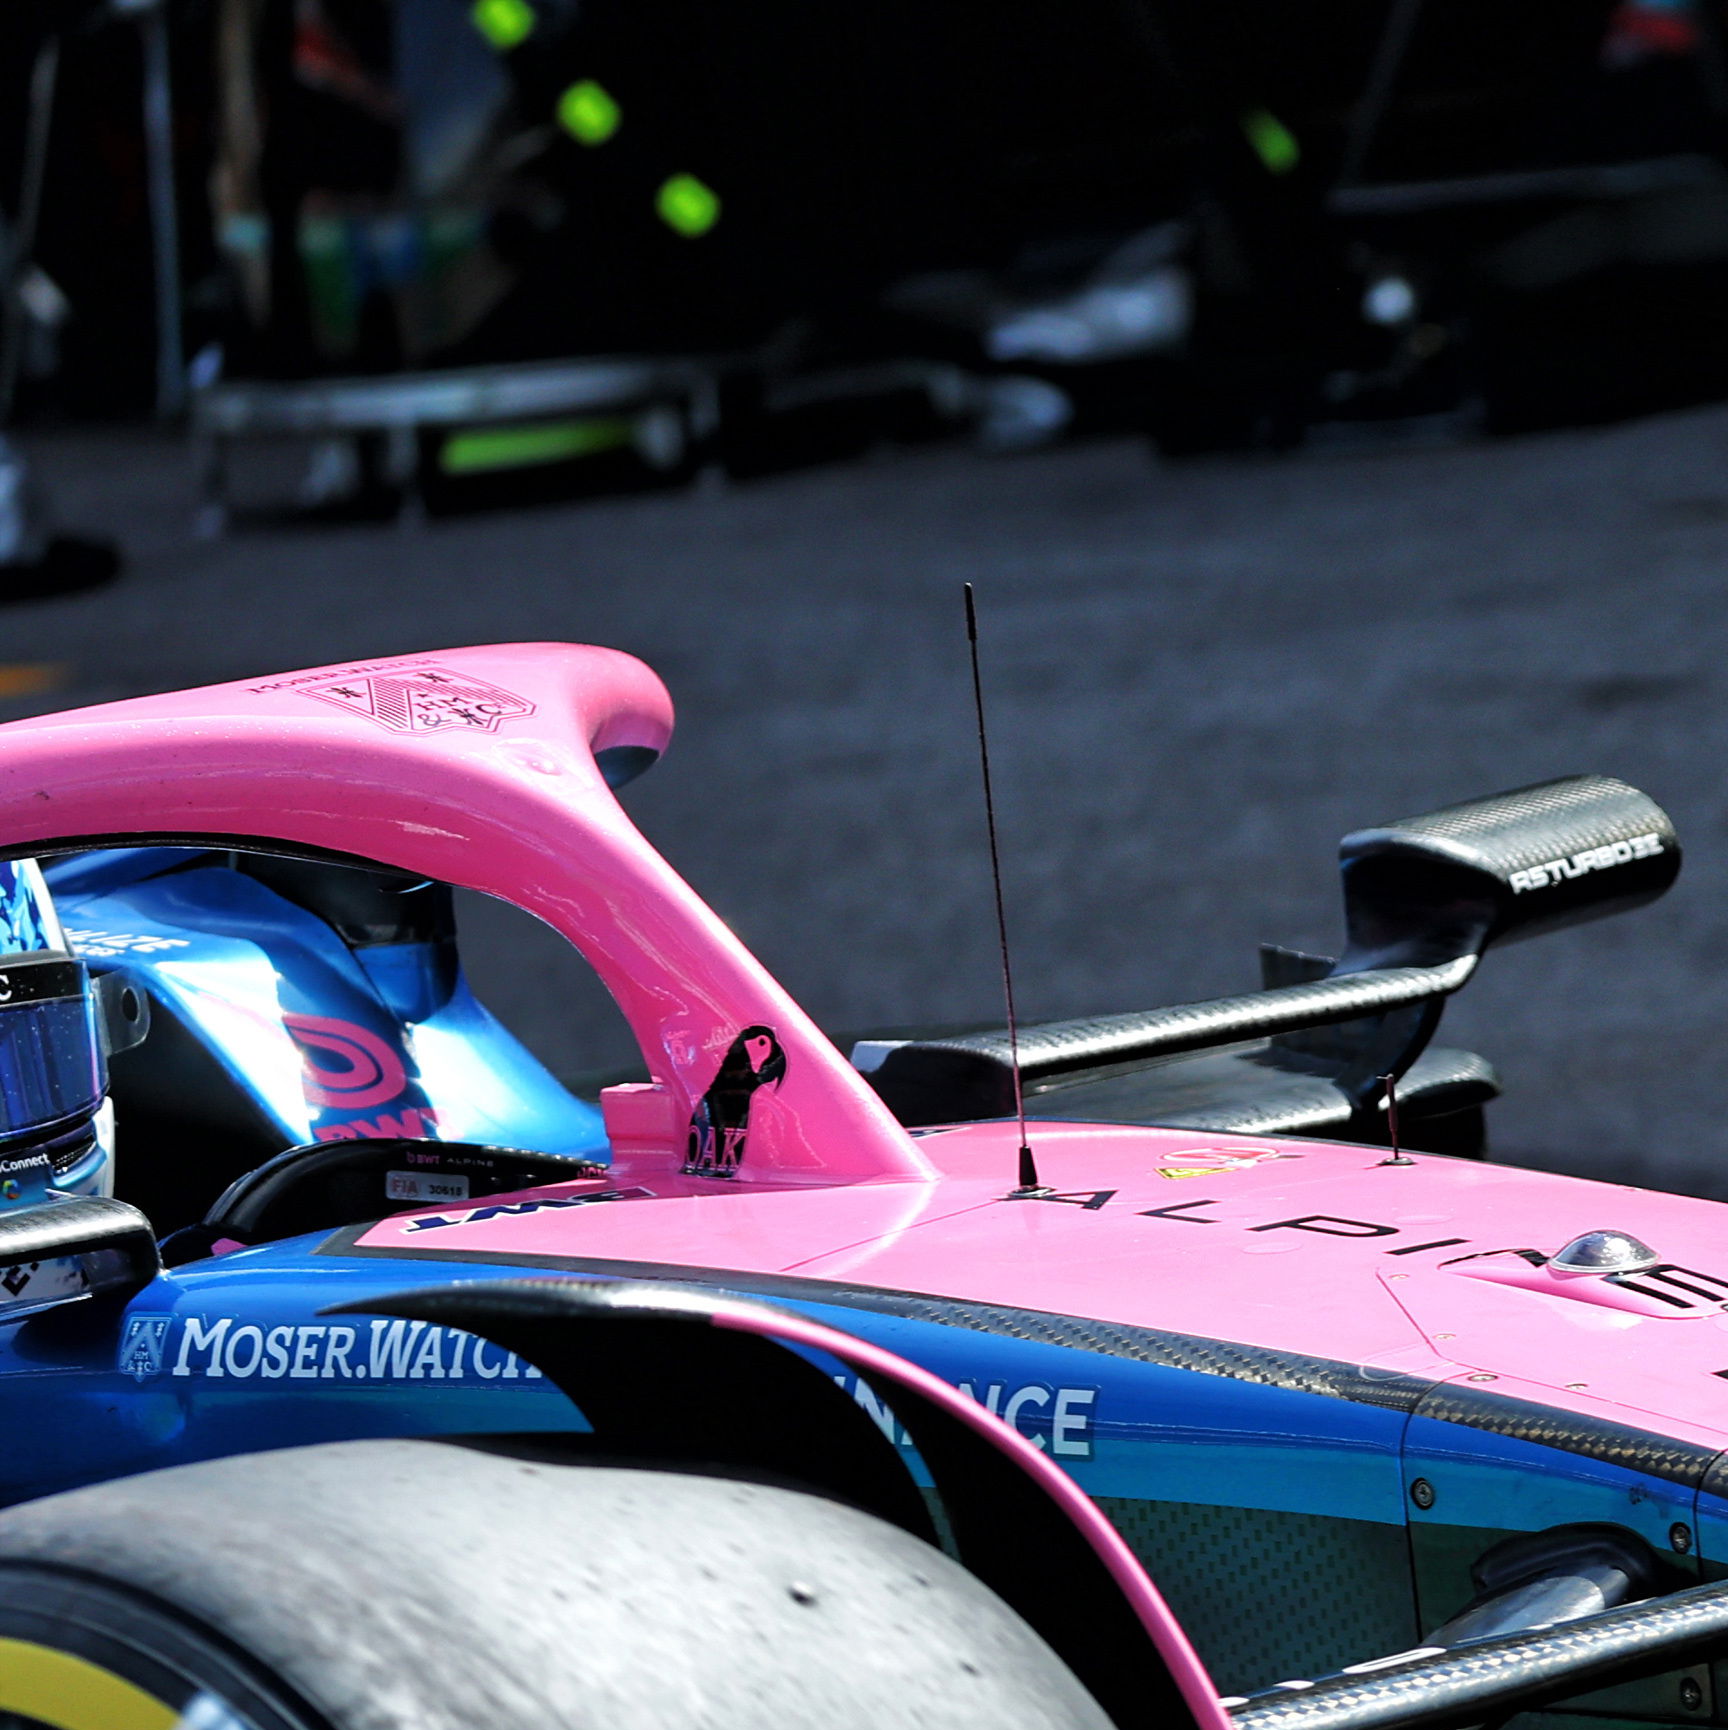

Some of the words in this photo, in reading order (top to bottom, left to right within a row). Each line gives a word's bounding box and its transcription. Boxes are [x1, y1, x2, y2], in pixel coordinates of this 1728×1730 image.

[685, 1125, 748, 1172] OAK
[0, 1153, 50, 1173] Connect
[447, 1157, 494, 1167] ALPINE
[391, 1176, 419, 1196] FIA
